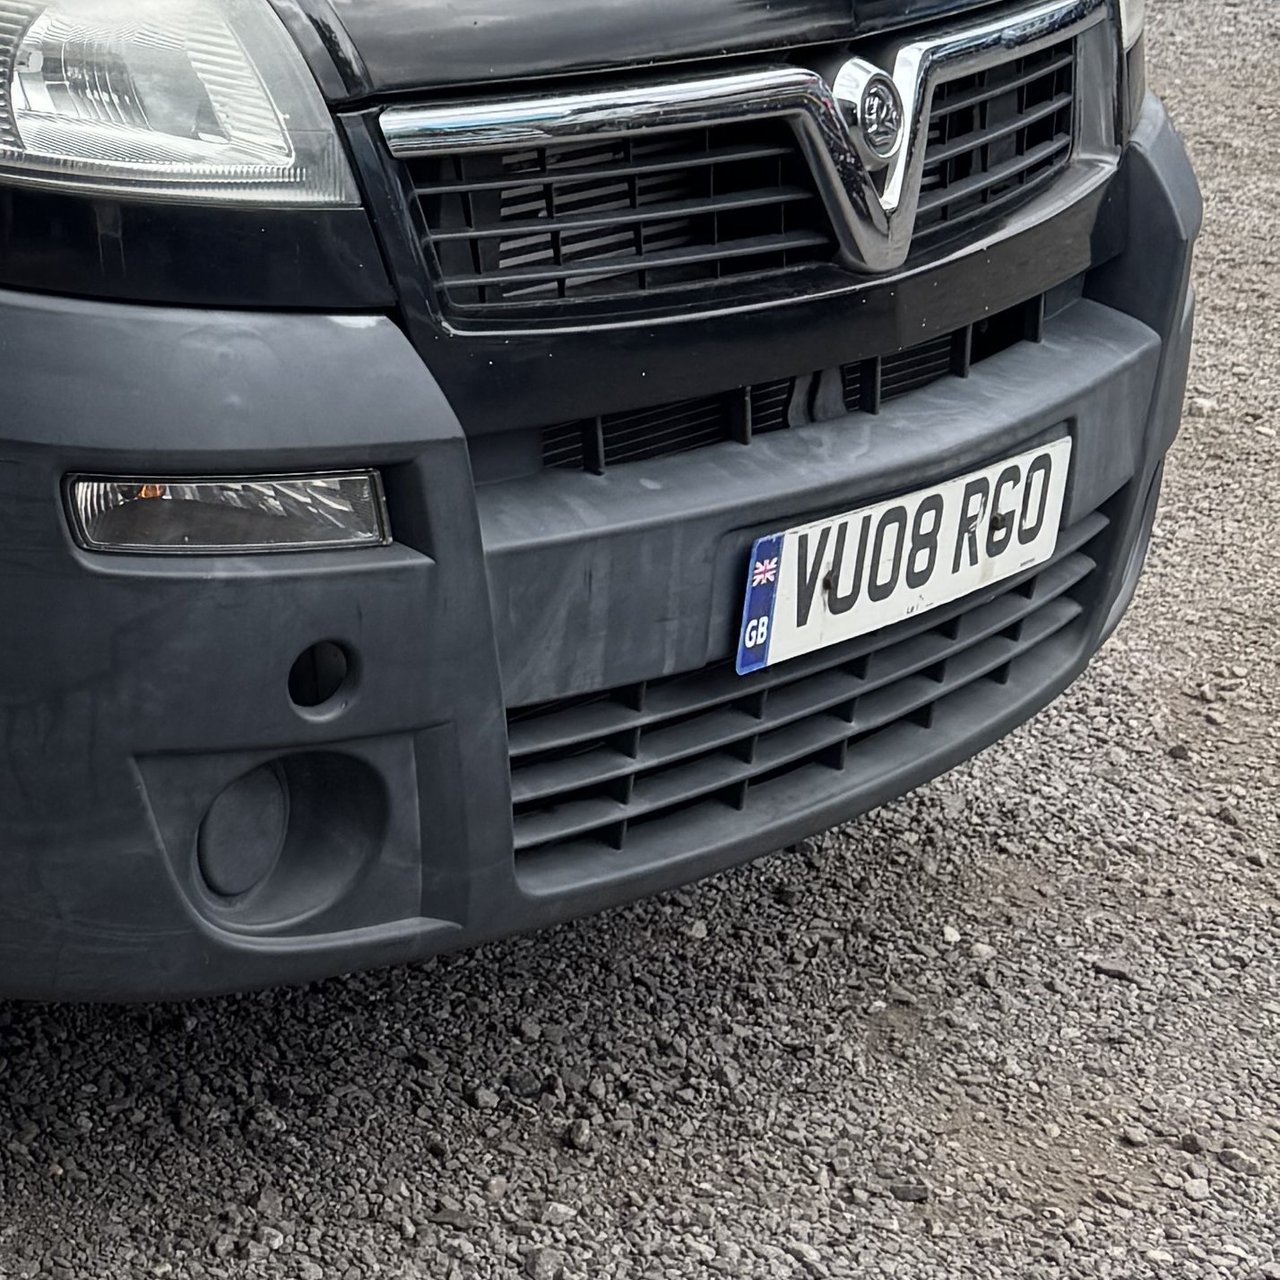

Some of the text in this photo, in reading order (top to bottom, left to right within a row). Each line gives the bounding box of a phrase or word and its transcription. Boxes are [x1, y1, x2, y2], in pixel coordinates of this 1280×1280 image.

[795, 453, 1053, 628] VU08 RGO
[743, 615, 769, 649] GB
